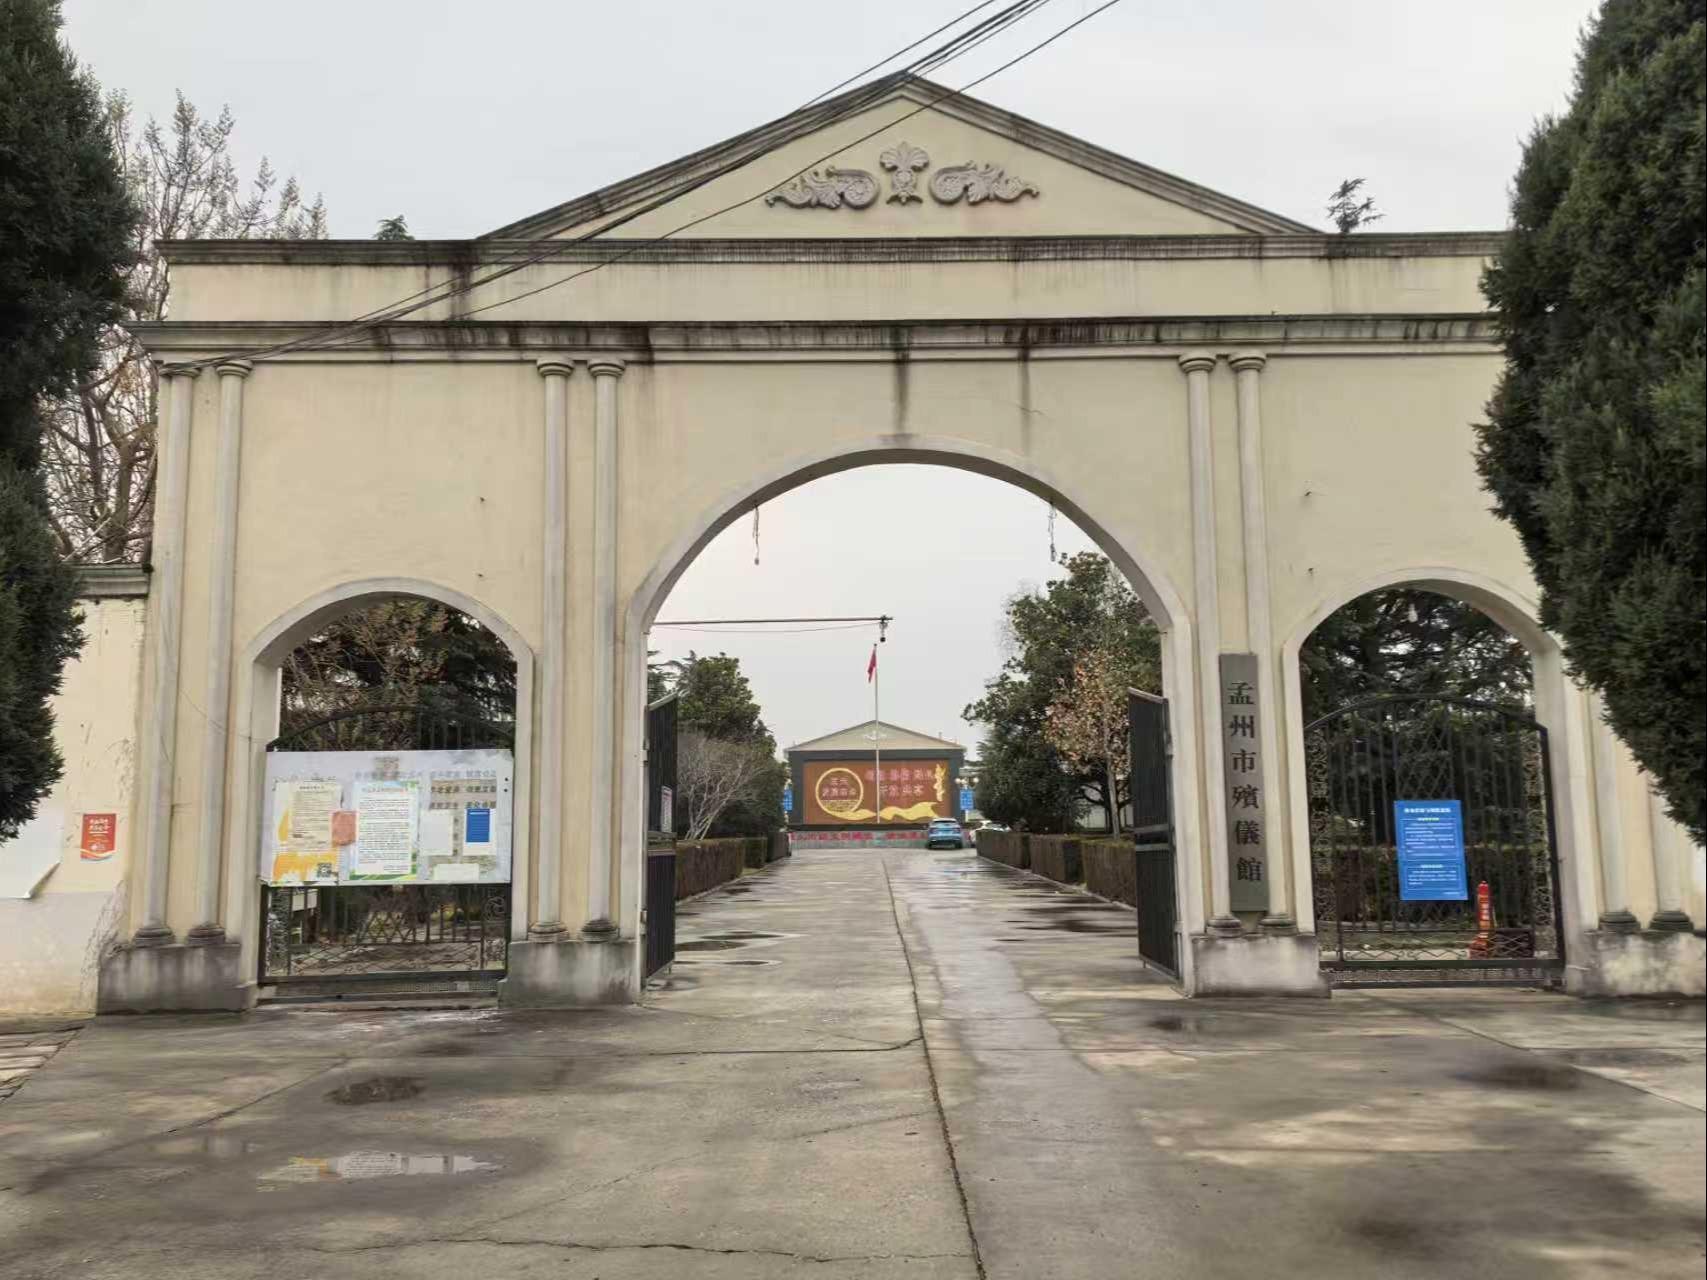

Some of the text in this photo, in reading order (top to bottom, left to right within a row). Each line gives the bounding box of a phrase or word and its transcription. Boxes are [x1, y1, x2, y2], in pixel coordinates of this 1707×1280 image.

[1227, 681, 1262, 881] 孟州市殯儀館
